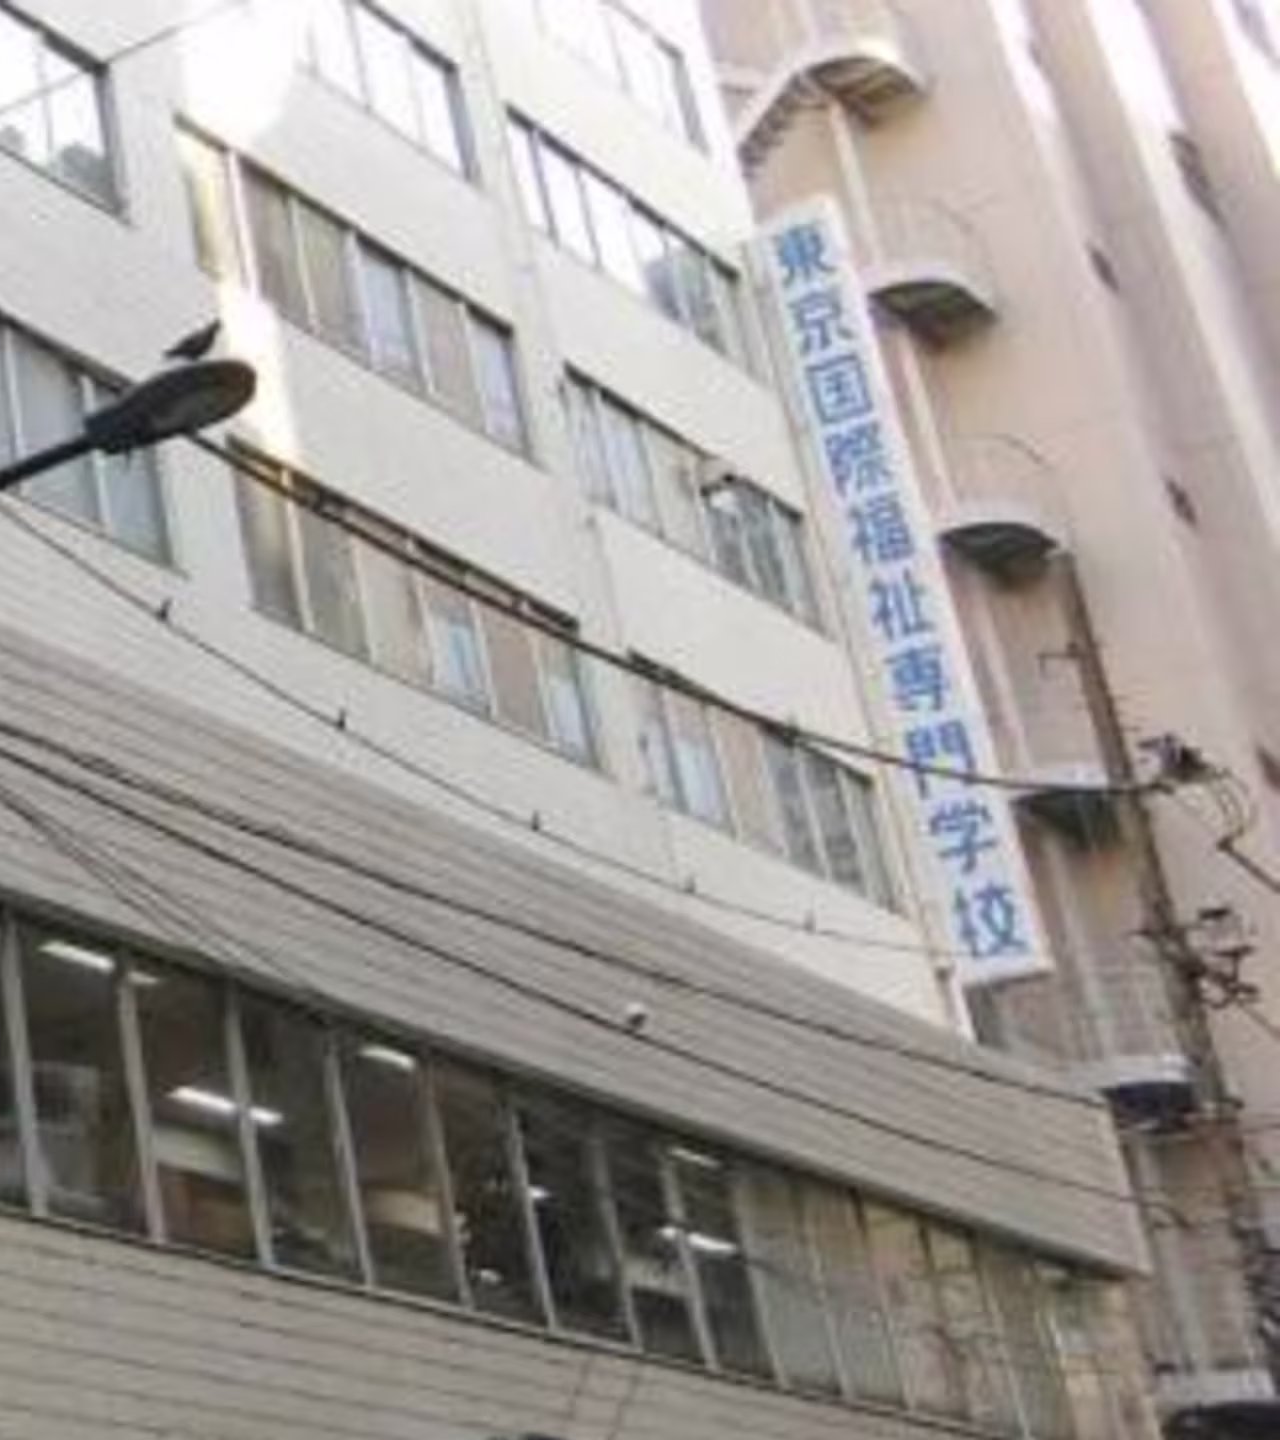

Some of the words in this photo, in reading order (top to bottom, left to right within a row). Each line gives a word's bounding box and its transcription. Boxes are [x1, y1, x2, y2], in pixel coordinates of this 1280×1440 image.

[772, 219, 1032, 960] 東京国際福祉専門学校
